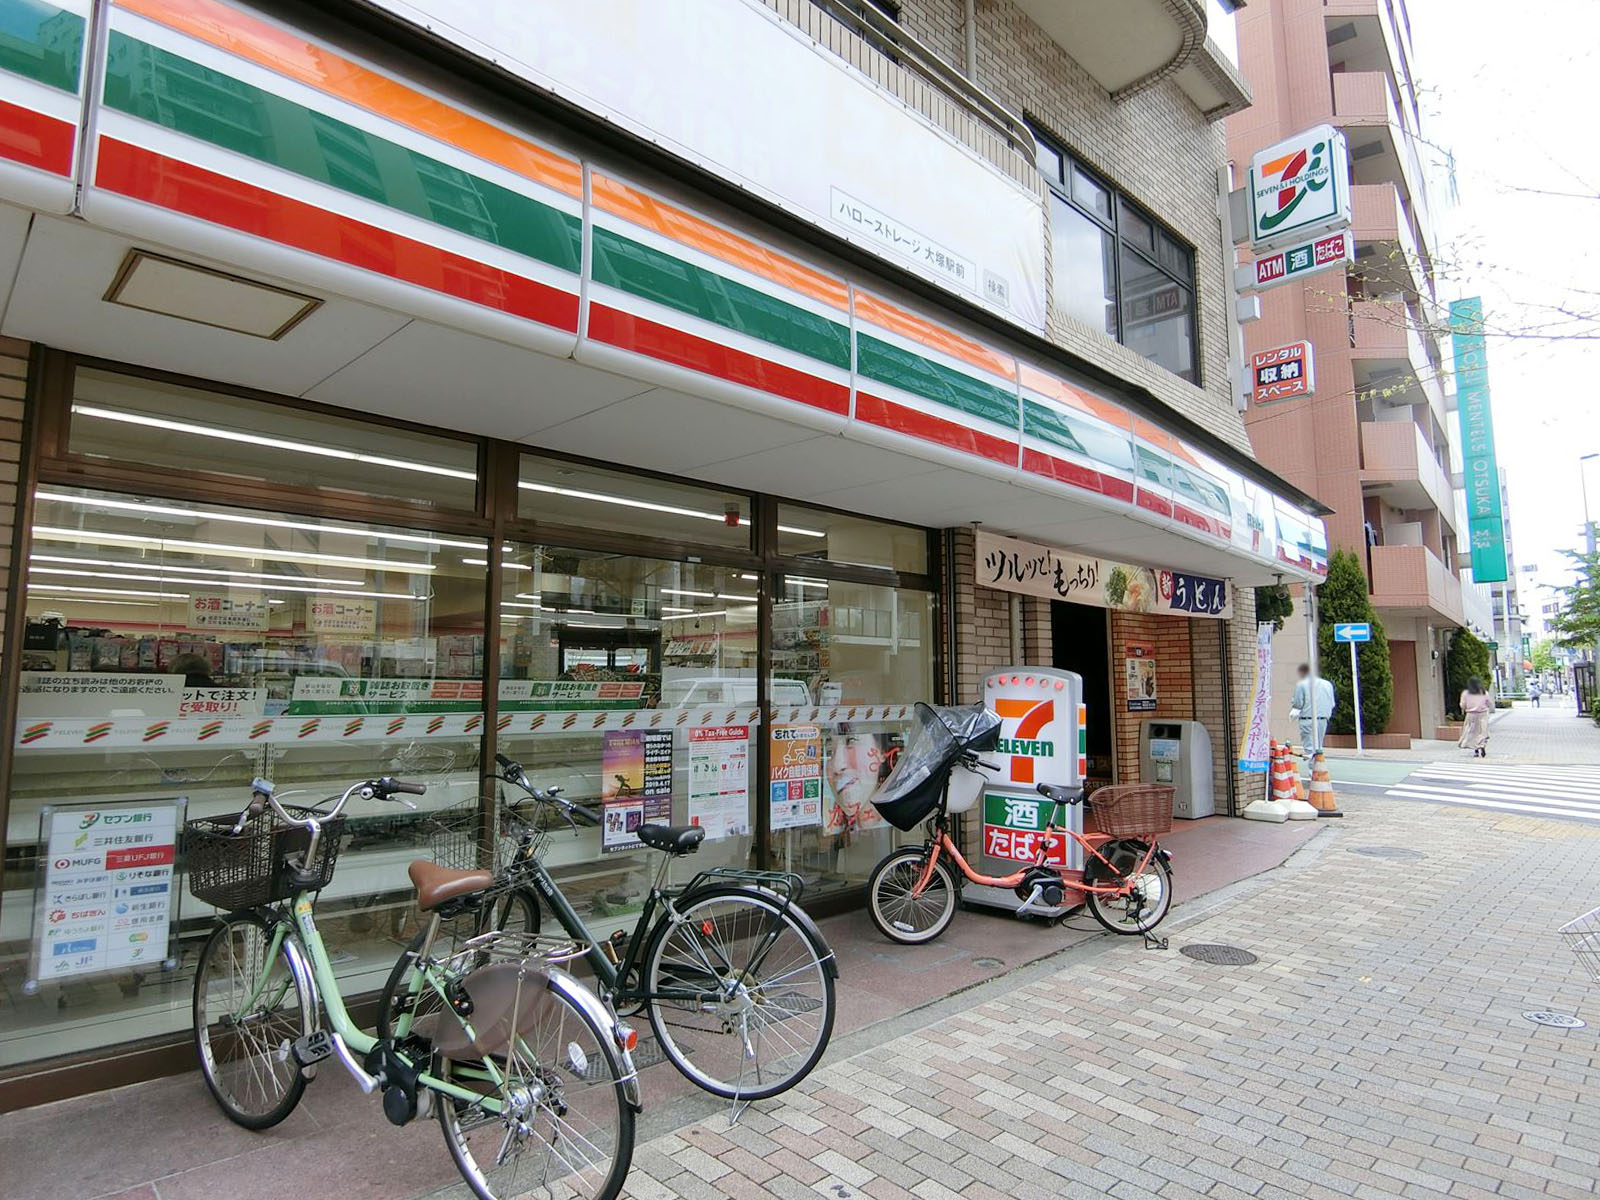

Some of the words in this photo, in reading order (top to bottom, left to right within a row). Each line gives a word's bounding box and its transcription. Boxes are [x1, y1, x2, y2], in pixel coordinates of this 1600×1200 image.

[1289, 166, 1329, 187] HOLDINGS
[840, 203, 920, 253] ハローストレージ
[924, 246, 965, 279] 大塚駅前
[1258, 258, 1283, 280] ATM
[1291, 249, 1308, 271] 酒
[1315, 239, 1344, 262] たばこ
[1255, 347, 1302, 366] レンタル
[1260, 362, 1299, 383] 収納
[1257, 381, 1303, 399] スペース
[1473, 459, 1491, 515] OTSUKA
[985, 550, 1052, 583] ツルッと!
[1053, 559, 1099, 597] もっちり!
[1176, 577, 1225, 610] うどん
[194, 596, 266, 611] お酒コーナー
[311, 603, 373, 616] お酒コーナー
[368, 690, 408, 699] サービス
[551, 691, 581, 699] サービス
[774, 729, 796, 740] 忘れて
[103, 812, 153, 824] セブン銀行
[1004, 799, 1040, 829] 酒
[94, 833, 154, 846] 三井住友銀行
[72, 857, 102, 867] MUFG
[116, 851, 165, 863] 三菱UFJ銀行
[128, 868, 170, 881] りそな銀行
[71, 908, 107, 920] ちばぎん
